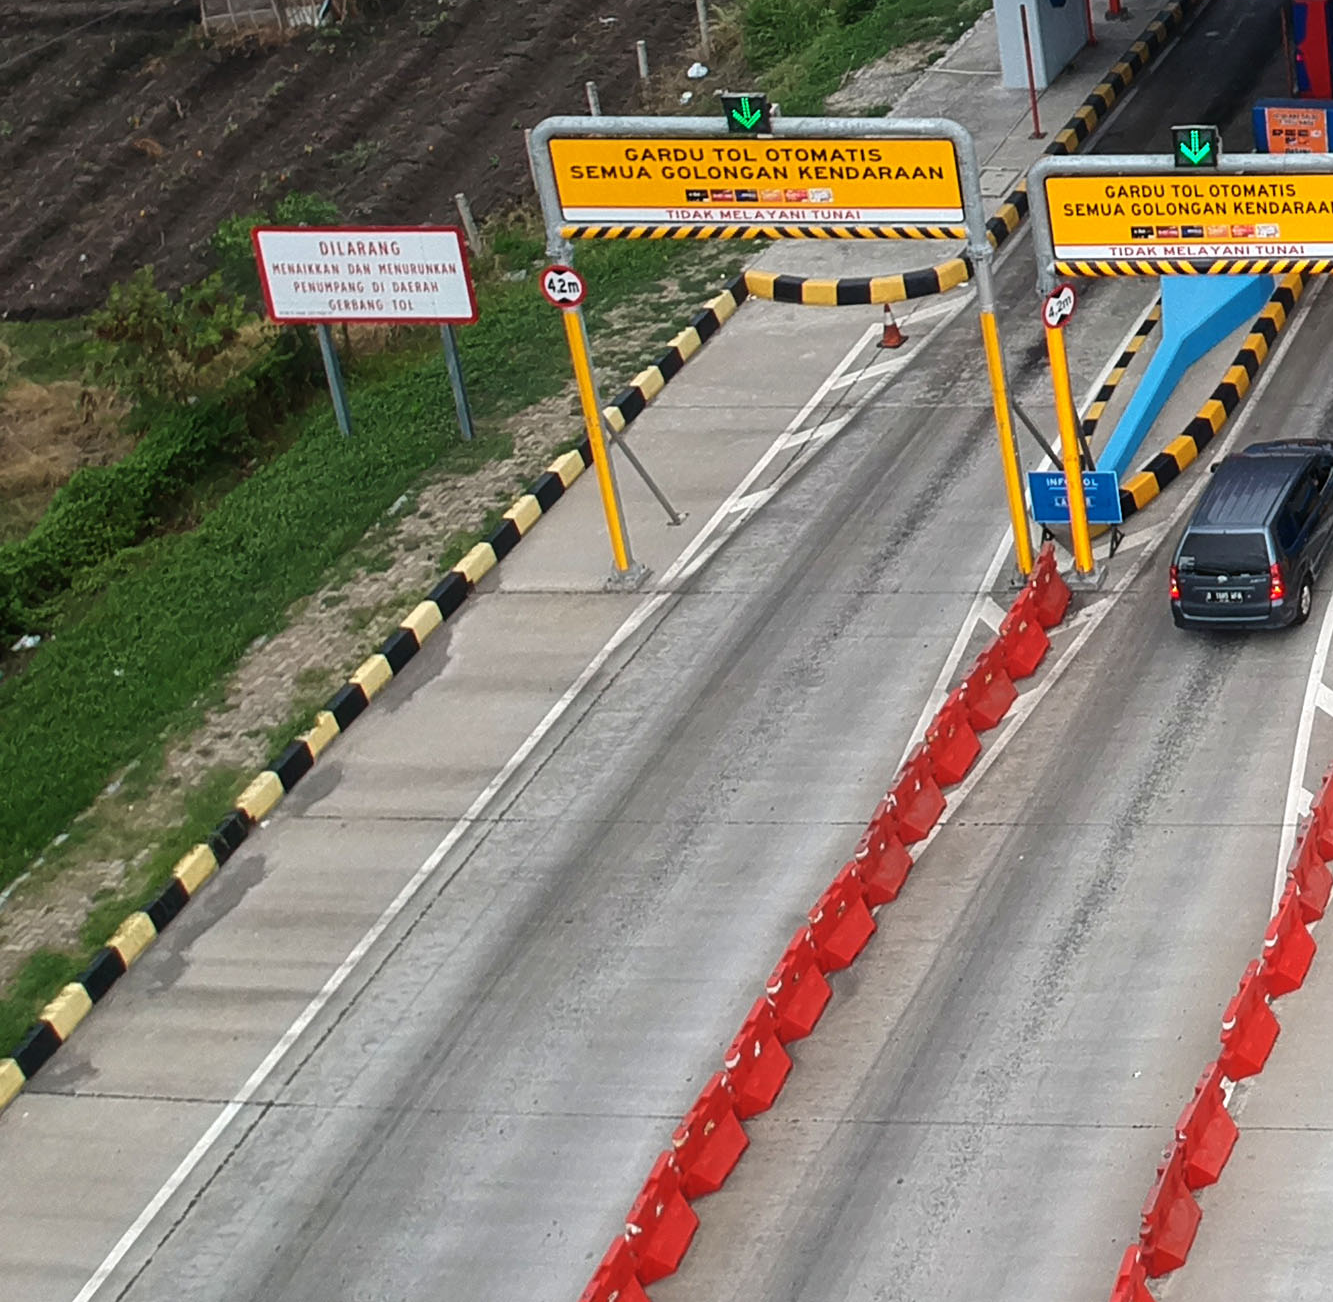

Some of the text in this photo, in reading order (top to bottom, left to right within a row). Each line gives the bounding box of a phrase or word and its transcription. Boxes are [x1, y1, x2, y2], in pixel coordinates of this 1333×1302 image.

[625, 148, 883, 162] GARDU TOL OTOMATIS
[571, 165, 944, 180] SEMUA GOLONGAN KENDARAAN
[1105, 184, 1296, 199] GARDU TOL OTOMATIS
[666, 210, 861, 220] TIDAK MELAYANI TUNAI
[1063, 203, 1126, 216] SEMUA
[1131, 202, 1227, 216] GOLONGAN
[319, 241, 401, 256] DILARANG
[1108, 245, 1305, 257] TIDAK MELAYANI TUNAI
[272, 263, 457, 276] MENAIKKAN DAN MENURUNKAN
[293, 281, 440, 294] PENUMPANG DI DAERAH
[328, 299, 415, 312] GERBANG TOL
[1046, 478, 1098, 487] INF OL
